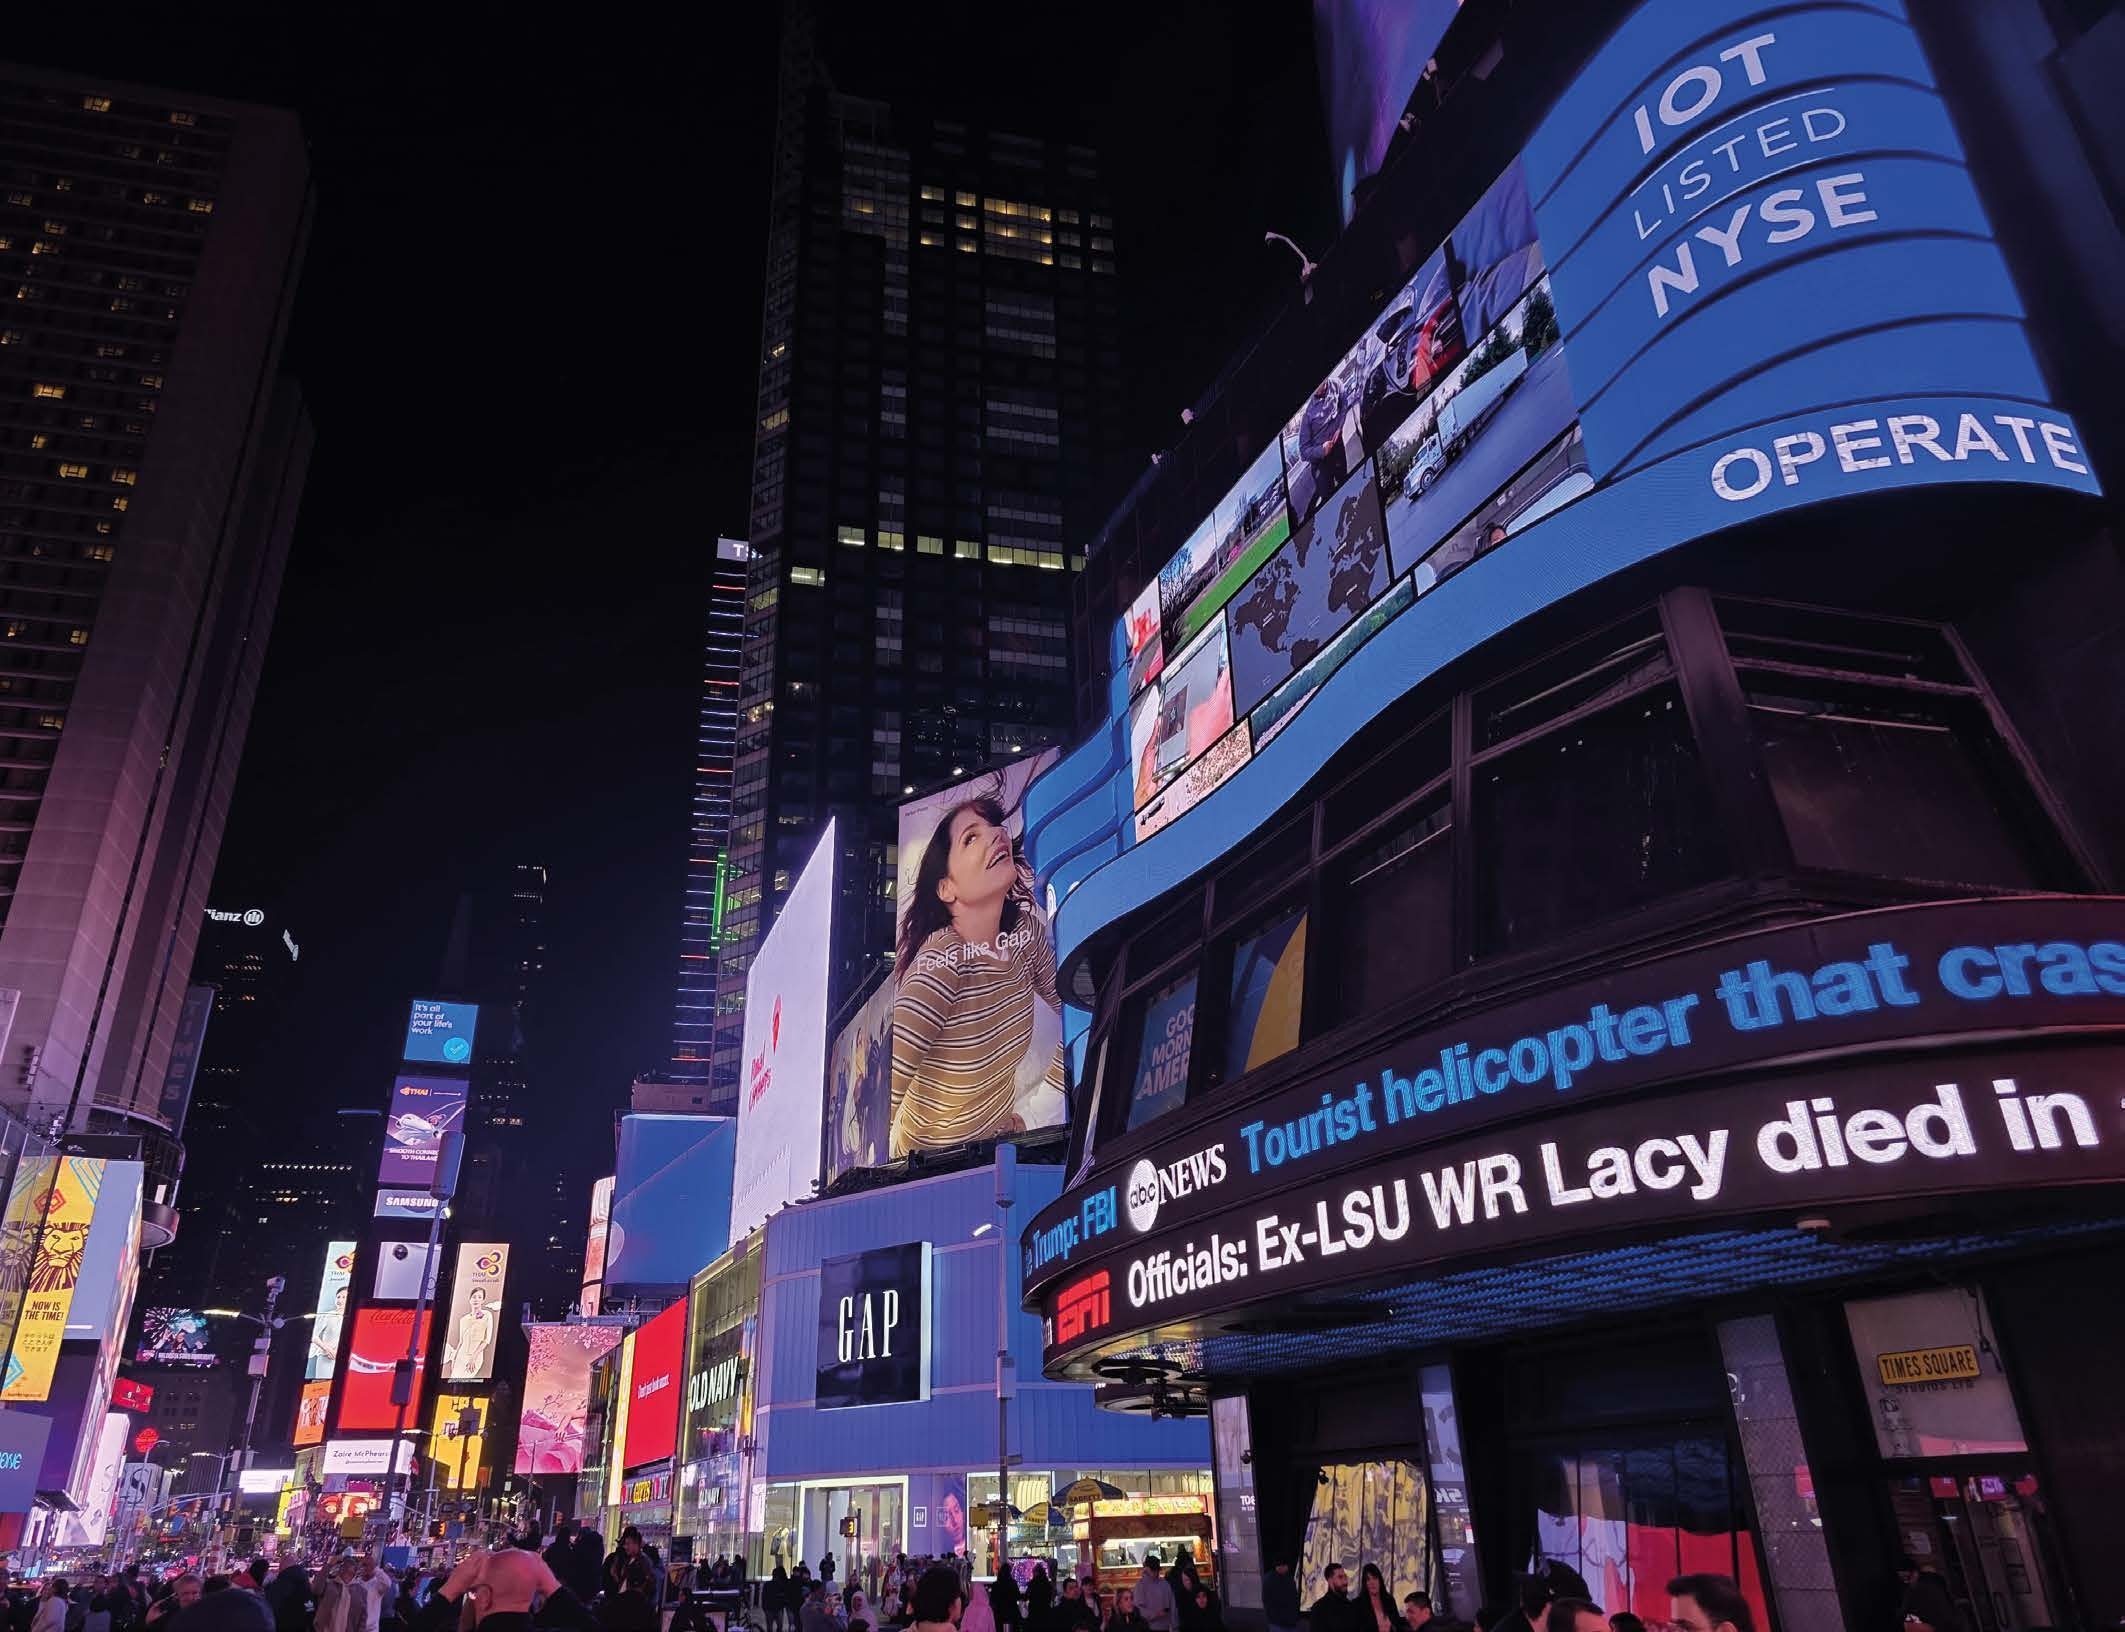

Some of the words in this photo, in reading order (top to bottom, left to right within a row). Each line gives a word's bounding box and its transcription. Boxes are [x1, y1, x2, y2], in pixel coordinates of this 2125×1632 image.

[1633, 33, 1775, 154] IOT
[1633, 107, 1847, 240] LISTED
[1647, 171, 1878, 319] NYSE
[1710, 412, 2089, 502] OPERATE
[917, 949, 958, 975] Feels
[963, 941, 990, 961] like
[1240, 1081, 1377, 1174] Tourist
[1382, 992, 1699, 1125] helicopter
[1715, 943, 1921, 1032] that
[1127, 1233, 1248, 1308] Officials:
[1256, 1179, 1411, 1272] Ex-LSU
[1420, 1152, 1529, 1226] WR
[1540, 1128, 1729, 1206] Lacy
[1756, 1083, 1977, 1174] died
[1992, 1078, 2100, 1151] in
[1157, 1143, 1228, 1206] NEWS
[1032, 1217, 1079, 1261] Trump:
[1082, 1186, 1118, 1242] FBI
[24, 1310, 41, 1320] THE
[41, 1311, 64, 1321] TIME!
[32, 1300, 52, 1311] NOW
[52, 1301, 61, 1311] IS
[837, 1288, 899, 1364] GAP
[689, 1372, 708, 1413] OLD
[708, 1355, 739, 1405] NAVY
[1881, 1355, 1921, 1379] TIMES
[1922, 1349, 1975, 1376] SQUARE
[915, 1511, 925, 1522] GAP
